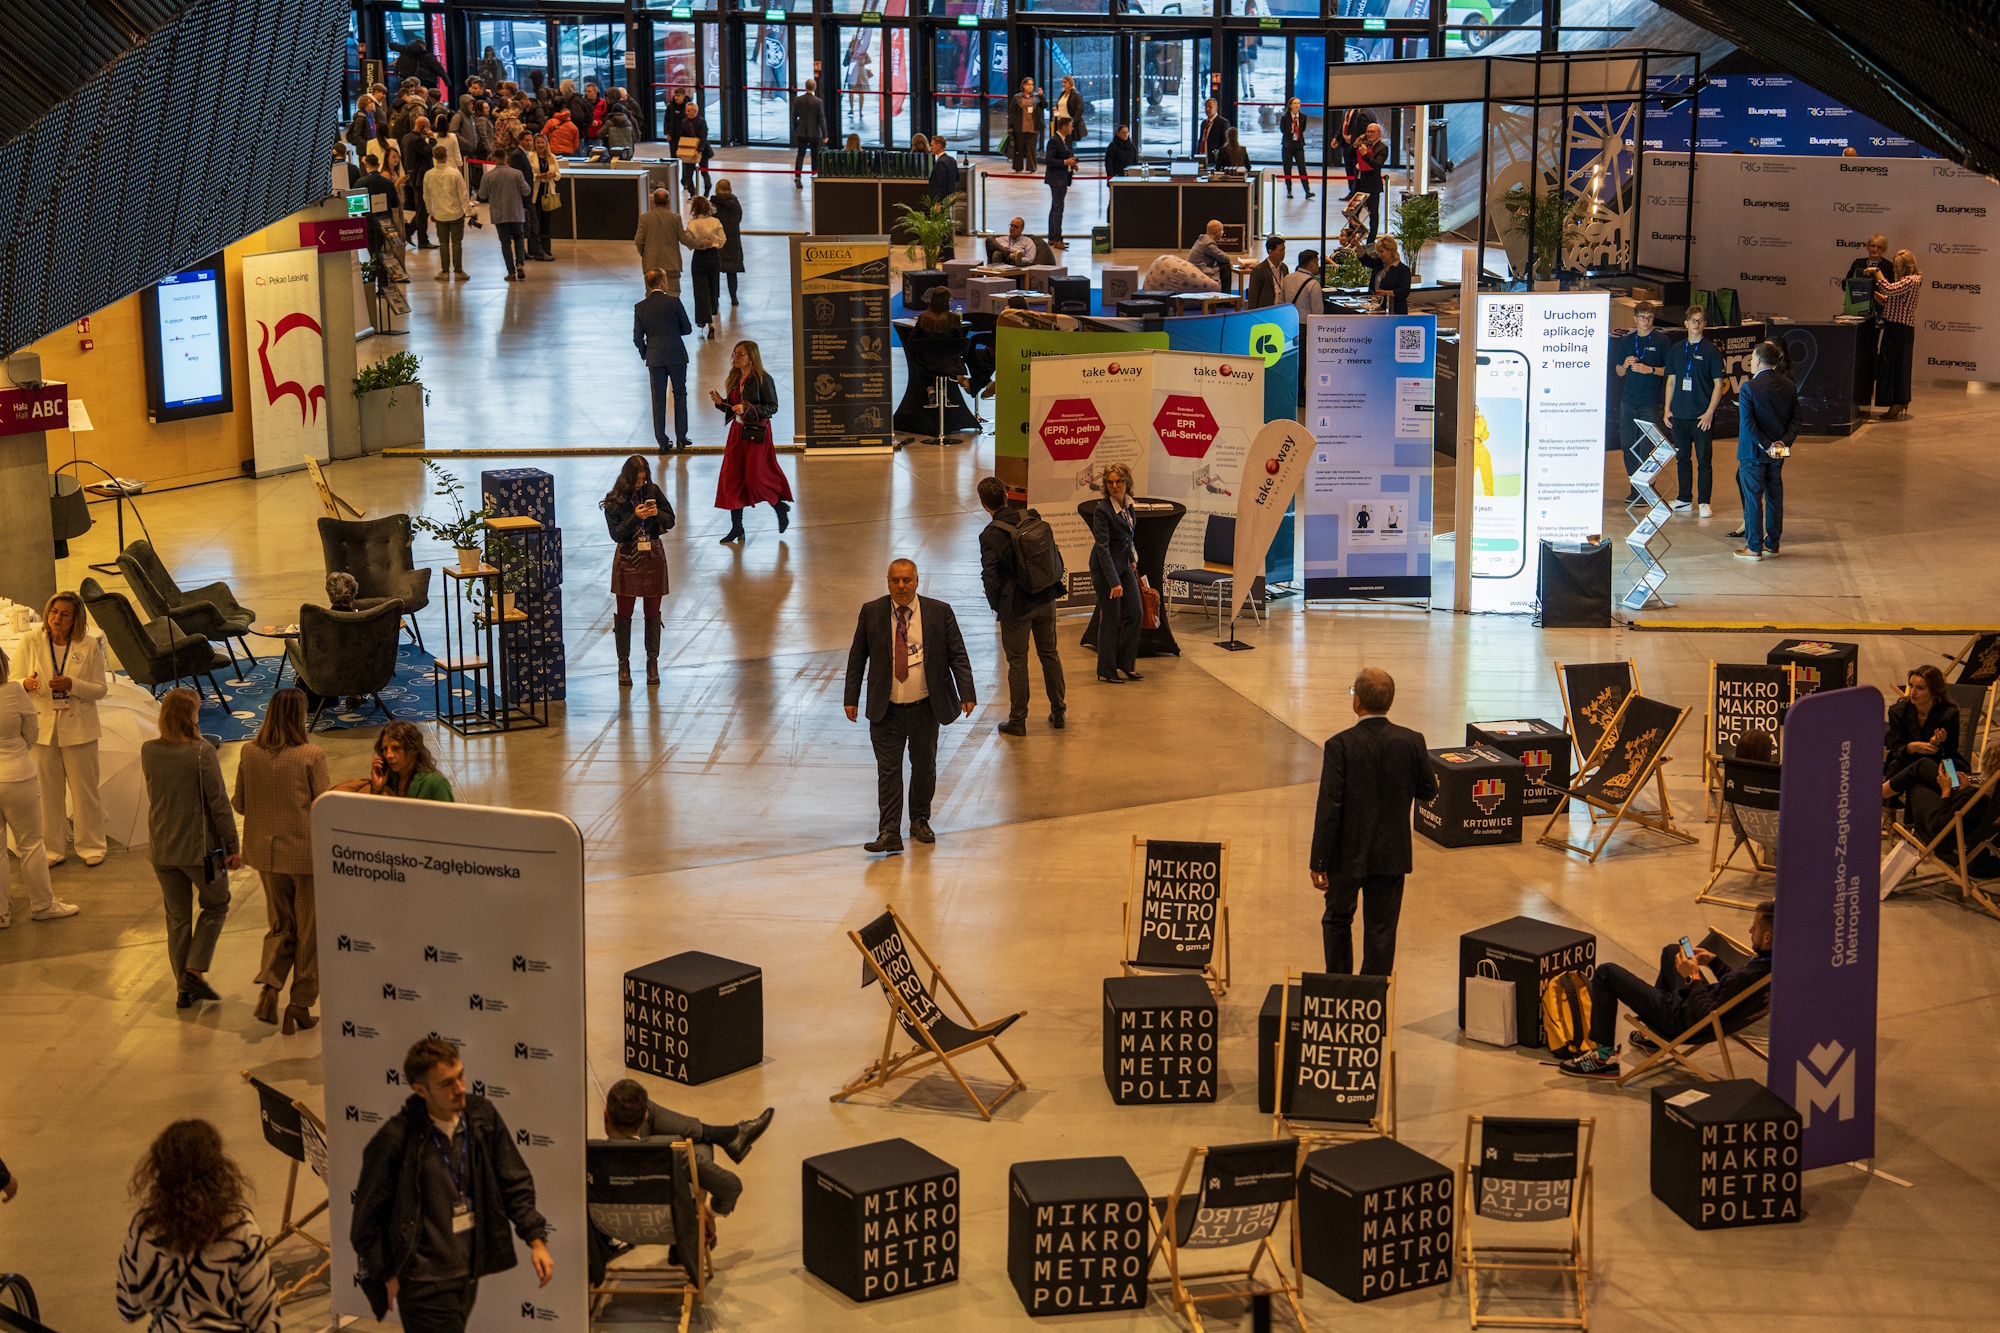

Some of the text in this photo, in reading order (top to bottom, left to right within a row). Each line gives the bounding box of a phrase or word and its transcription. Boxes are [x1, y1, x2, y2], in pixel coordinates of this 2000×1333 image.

[1748, 107, 1786, 116] Business
[1810, 137, 1848, 146] Business
[1840, 164, 1888, 174] Business
[1743, 198, 1790, 209] Business
[1936, 205, 1986, 215] Business
[269, 273, 309, 284] Pekao Leasing
[1740, 272, 1787, 283] Business
[1932, 281, 1981, 292] Business
[1544, 310, 1597, 320] Uruchom
[1317, 325, 1346, 333] Przejdź
[1543, 326, 1595, 338] aplikację
[1318, 336, 1372, 344] transformację
[1542, 343, 1588, 354] mobilną
[1318, 347, 1358, 355] sprzedaży
[1194, 367, 1217, 376] take
[1552, 359, 1590, 368] 'merce
[1927, 357, 1976, 367] Business
[1082, 367, 1105, 377] take
[13, 402, 28, 411] Hala
[16, 412, 28, 420] Hall
[32, 399, 63, 418] ABC
[1044, 425, 1068, 436] (EPR)
[1077, 424, 1100, 435] pełna
[1177, 419, 1195, 428] EPR
[1054, 437, 1089, 445] obsługa
[1161, 429, 1212, 441] Full-Service
[1255, 478, 1274, 505] take
[1719, 680, 1779, 698] MIKRO
[1719, 698, 1779, 715] MAKRO
[1718, 715, 1778, 731] METRO
[1718, 731, 1778, 747] POA
[1463, 817, 1513, 828] KATOWICE
[332, 844, 520, 879] Górnośląsko-Zagłębiowska
[1831, 740, 1851, 968] Górnośląsko-Zagłębiowska
[333, 861, 405, 883] Metropolia
[1148, 858, 1217, 880] MIKRO
[1147, 879, 1215, 900] MAKRO
[1144, 900, 1214, 921] METRO
[1846, 875, 1860, 965] Metropolia
[1143, 920, 1212, 940] POLIA
[1185, 943, 1210, 951] gzm.pl
[1540, 942, 1595, 974] MIKRO
[625, 978, 689, 1012] MIKRO
[1304, 995, 1382, 1020] MIKRO
[625, 1001, 689, 1035] MAKRO
[1121, 1009, 1213, 1029] MIKRO
[625, 1023, 689, 1058] METRO
[1302, 1019, 1381, 1044] MAKRO
[1121, 1033, 1213, 1052] MAKRO
[626, 1046, 689, 1081] POLIA
[1300, 1043, 1379, 1068] METRO
[1120, 1056, 1212, 1075] METRO
[1298, 1066, 1376, 1091] POLIA
[1120, 1080, 1211, 1099] POLIA
[1347, 1093, 1375, 1103] gzm.pl
[1702, 1120, 1798, 1145] MIKRO
[1702, 1146, 1798, 1171] MAKRO
[1701, 1172, 1797, 1197] METRO
[865, 1177, 957, 1216] MIKRO
[1364, 1178, 1452, 1215] MIKRO
[1036, 1201, 1142, 1227] MIKRO
[1702, 1198, 1796, 1222] POLIA
[864, 1204, 956, 1243] MAKRO
[1363, 1205, 1451, 1242] MAKRO
[864, 1230, 956, 1270] METRO
[1036, 1228, 1141, 1254] MAKRO
[1362, 1232, 1450, 1269] METRO
[864, 1257, 955, 1297] POLIA
[1034, 1256, 1140, 1282] METRO
[1362, 1258, 1449, 1296] POLIA
[1034, 1283, 1138, 1309] POLIA
